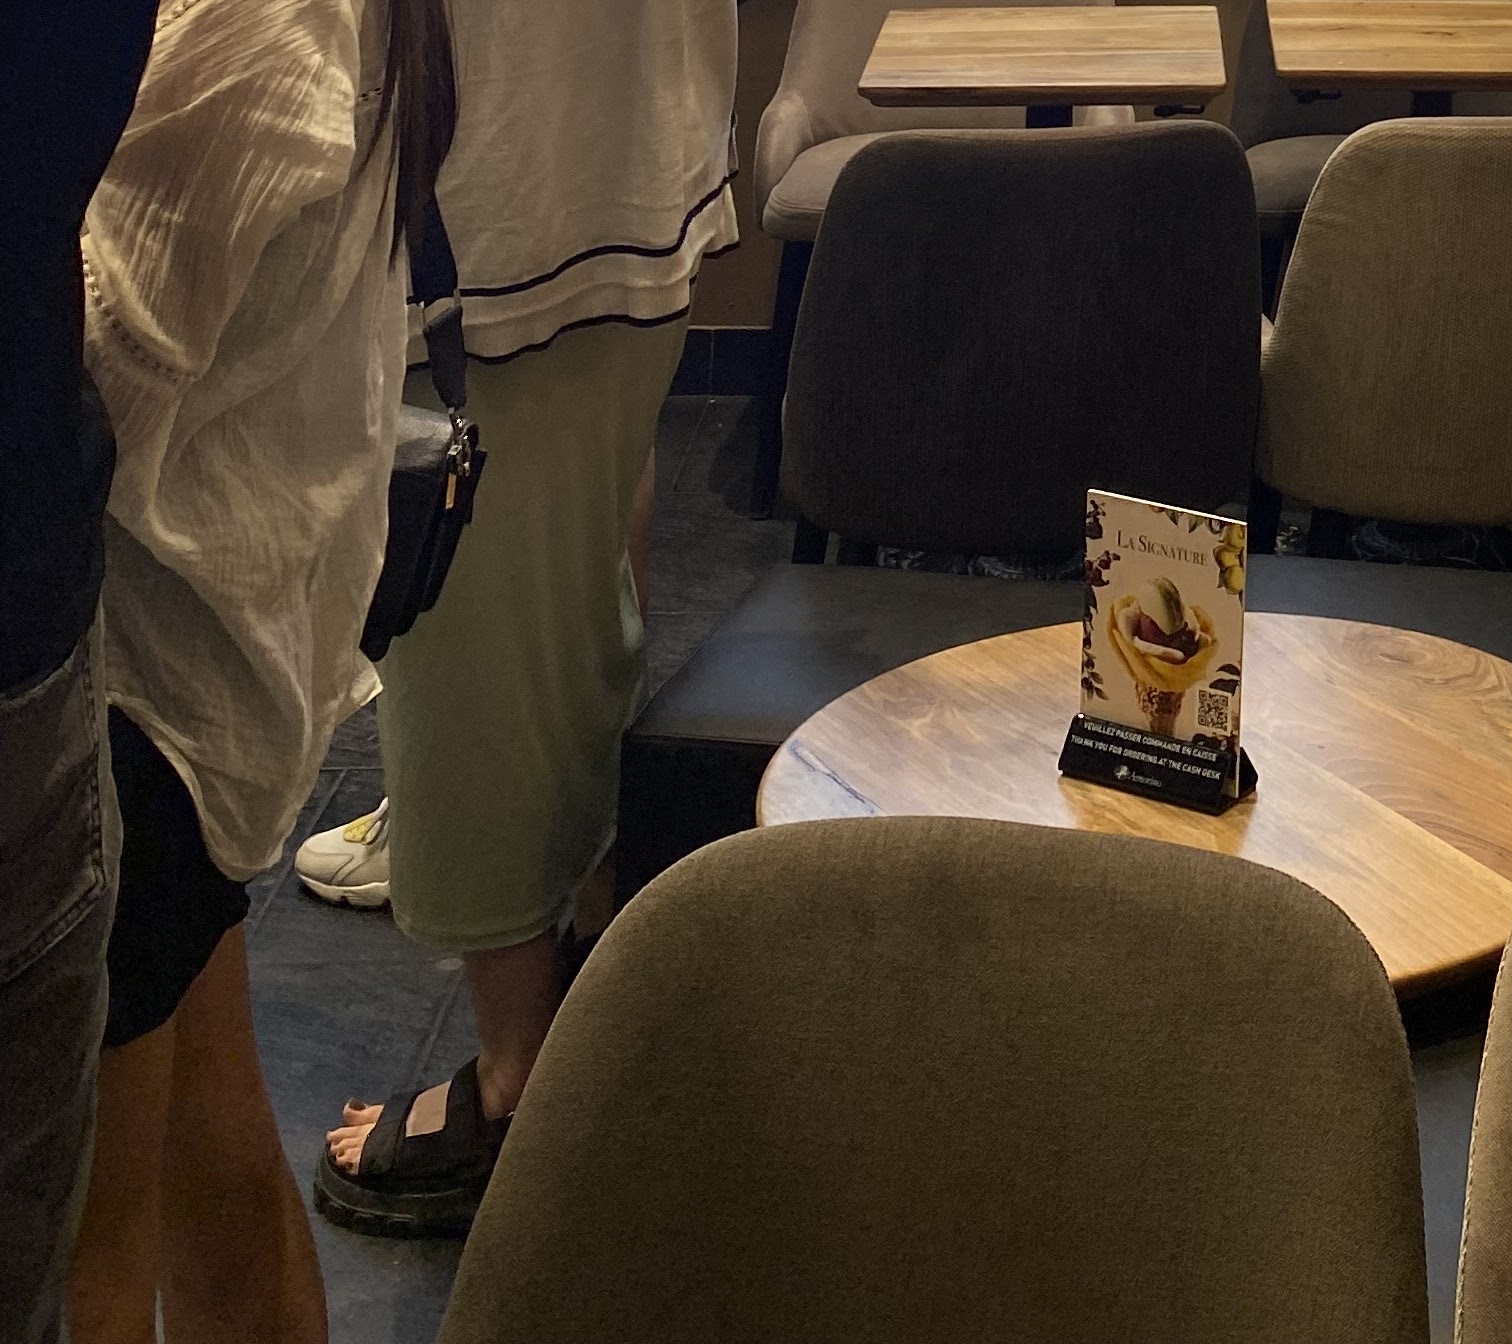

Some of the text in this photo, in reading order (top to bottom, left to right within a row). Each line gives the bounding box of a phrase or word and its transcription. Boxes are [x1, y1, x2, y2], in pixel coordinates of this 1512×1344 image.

[1116, 729, 1142, 743] PASSER
[1094, 739, 1109, 752] YOU
[1168, 761, 1182, 771] THE
[1182, 763, 1201, 775] CASH
